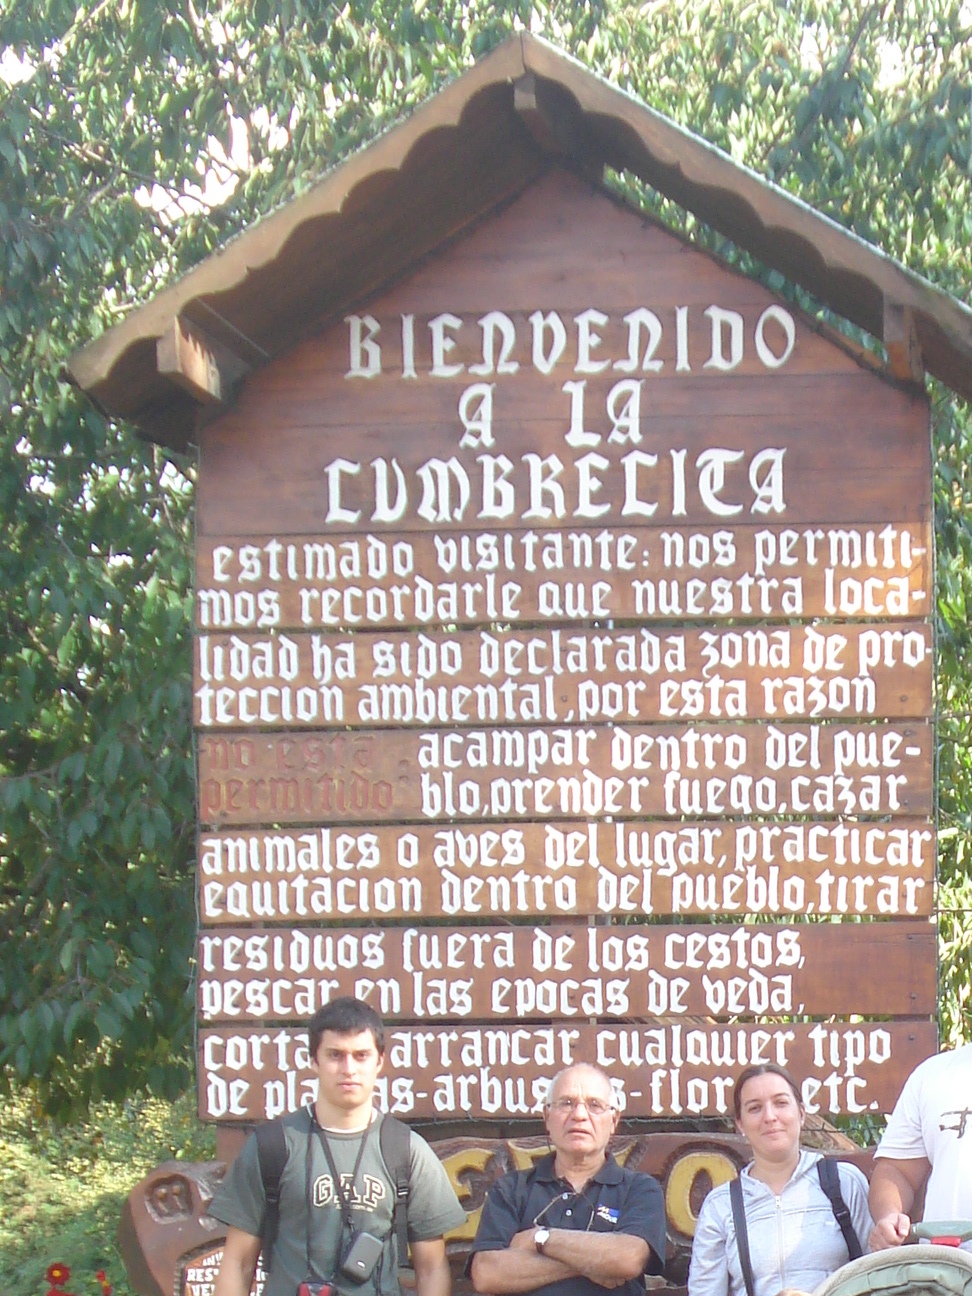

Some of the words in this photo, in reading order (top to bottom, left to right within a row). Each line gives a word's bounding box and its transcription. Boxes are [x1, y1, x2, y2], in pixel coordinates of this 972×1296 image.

[344, 304, 796, 379] BIENVENIDO
[458, 382, 496, 448] A
[561, 378, 646, 447] LA
[213, 534, 414, 583] estimado
[660, 530, 737, 567] nos
[198, 588, 281, 627] mos
[299, 573, 522, 624] recordarle
[631, 571, 803, 615] nuestra
[199, 632, 300, 682] lidad
[311, 633, 357, 684] ha
[372, 633, 463, 678] sido
[480, 629, 686, 676] declarada
[802, 626, 848, 673] de
[195, 682, 345, 726] teccion
[659, 673, 748, 717] esta
[417, 728, 597, 774] acampar
[610, 726, 748, 771] dentro
[764, 725, 821, 770] del
[201, 829, 381, 875] animales
[397, 832, 420, 869] o
[432, 829, 526, 868] aves
[544, 824, 600, 871] del
[441, 869, 577, 914] dentro
[597, 866, 654, 914] del
[200, 929, 385, 973] residuos
[402, 928, 515, 972] fuera
[532, 928, 576, 972] de
[587, 927, 650, 972] los
[200, 978, 340, 1017] pescar
[413, 971, 475, 1017] las
[491, 976, 631, 1017] epocas
[647, 969, 691, 1016] de
[390, 1028, 581, 1069] arrancar
[808, 1023, 892, 1078] tipo
[206, 1072, 251, 1117] de
[313, 1173, 386, 1208] GAP
